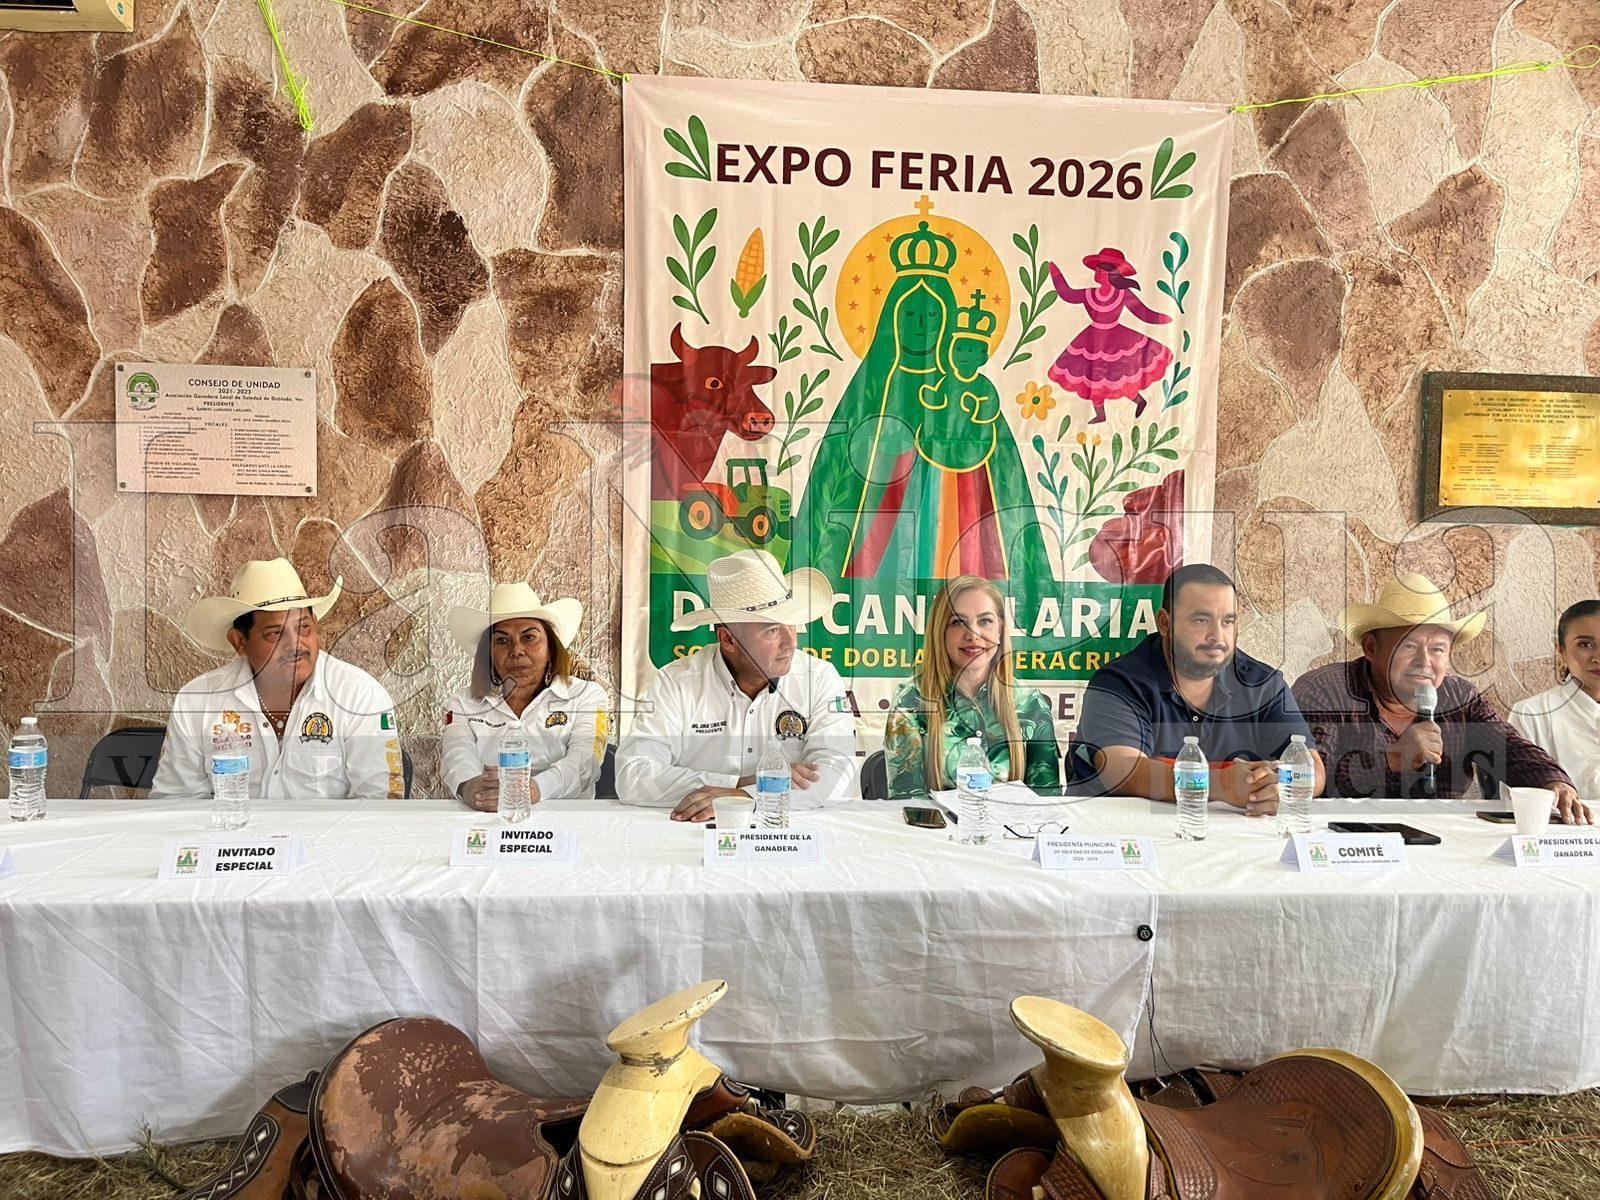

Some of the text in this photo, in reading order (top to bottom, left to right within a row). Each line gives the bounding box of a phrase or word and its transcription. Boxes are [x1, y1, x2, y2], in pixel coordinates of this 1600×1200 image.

[716, 143, 1144, 201] EXPO FERIA 2026
[188, 378, 280, 389] CONSEJO DE UNIDAD
[822, 592, 1158, 639] CANLARIA
[844, 648, 925, 668] DOBLA
[501, 830, 554, 840] INVITADO
[218, 847, 276, 858] INVITADO
[500, 844, 552, 854] ESPECIAL
[1338, 844, 1384, 857] COMITÉ
[215, 861, 273, 872] ESPECIAL
